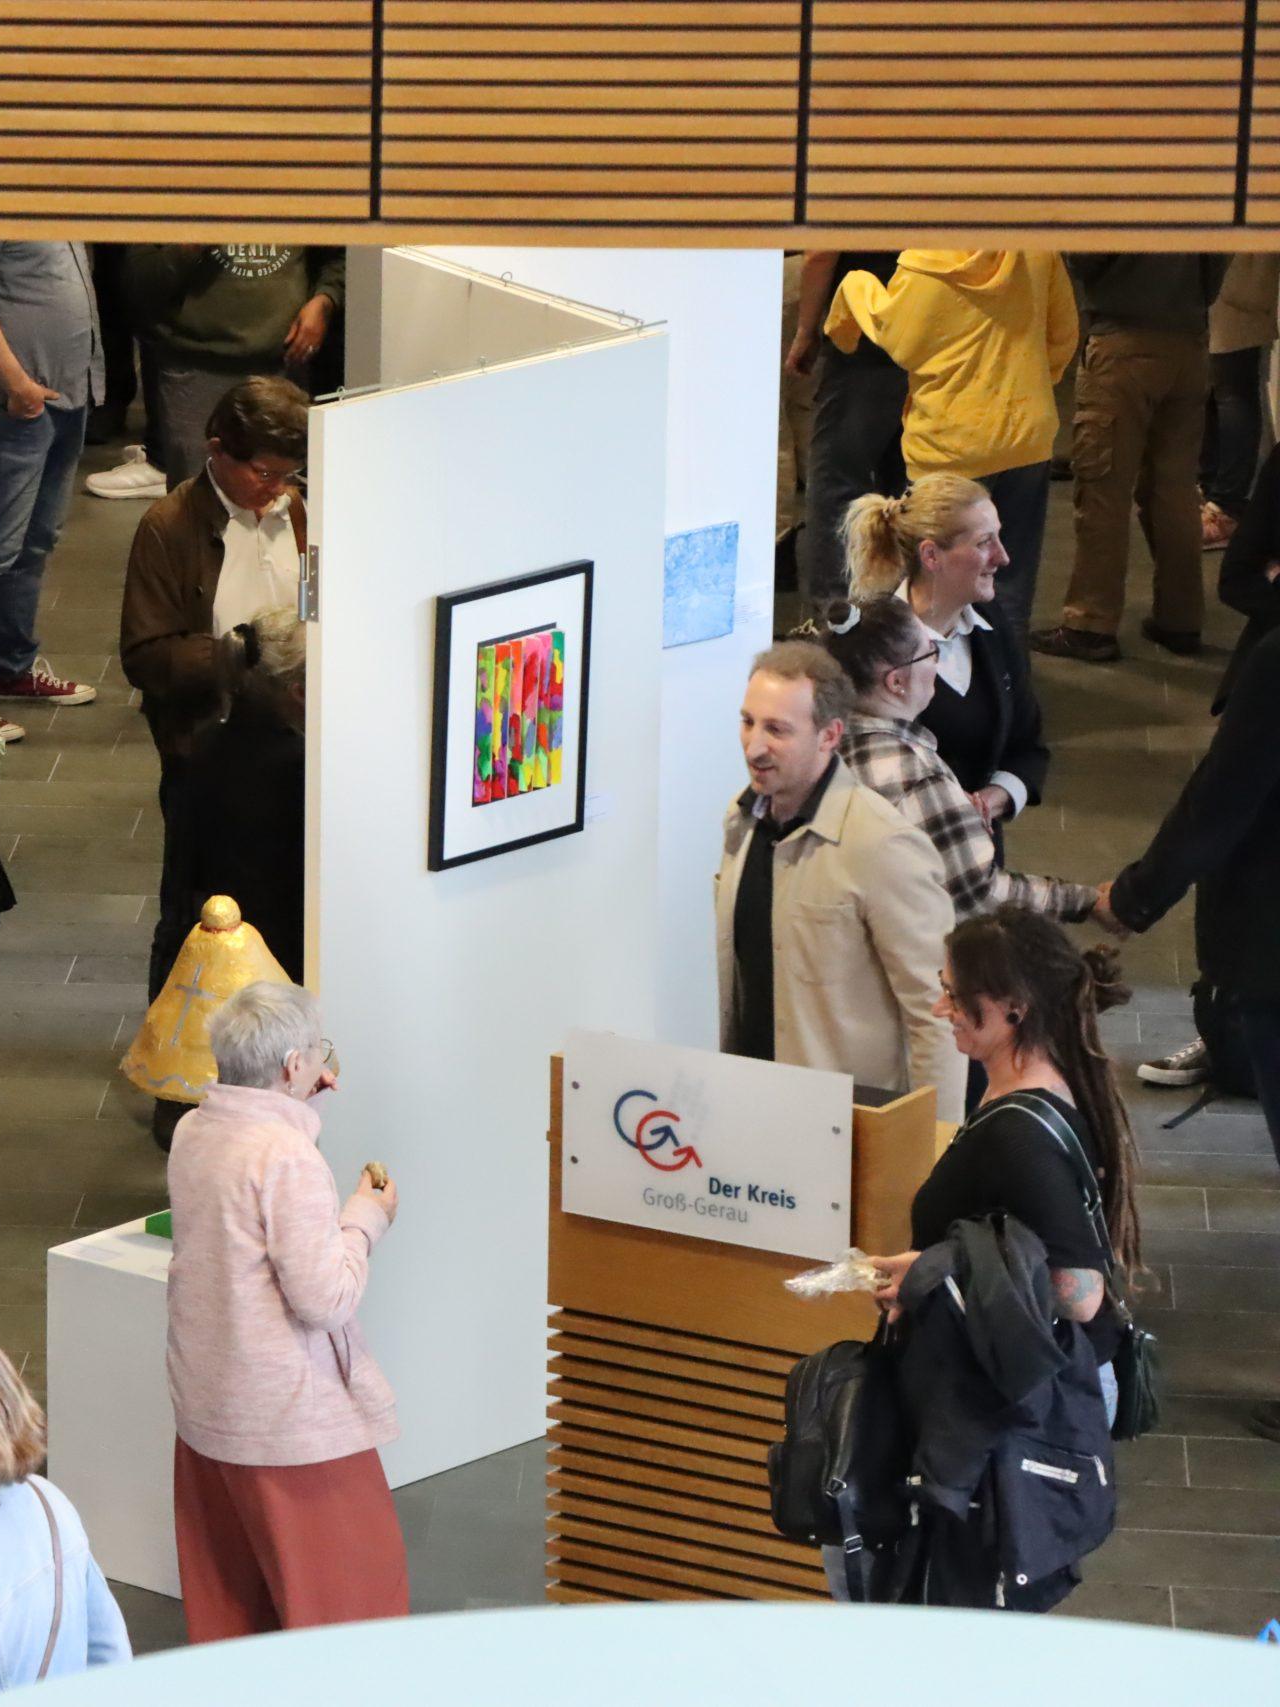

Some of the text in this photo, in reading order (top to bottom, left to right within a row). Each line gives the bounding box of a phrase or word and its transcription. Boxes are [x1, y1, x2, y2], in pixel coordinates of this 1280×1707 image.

[642, 1187, 749, 1223] Groß-Gerau
[709, 1176, 797, 1210] Der Kreis
